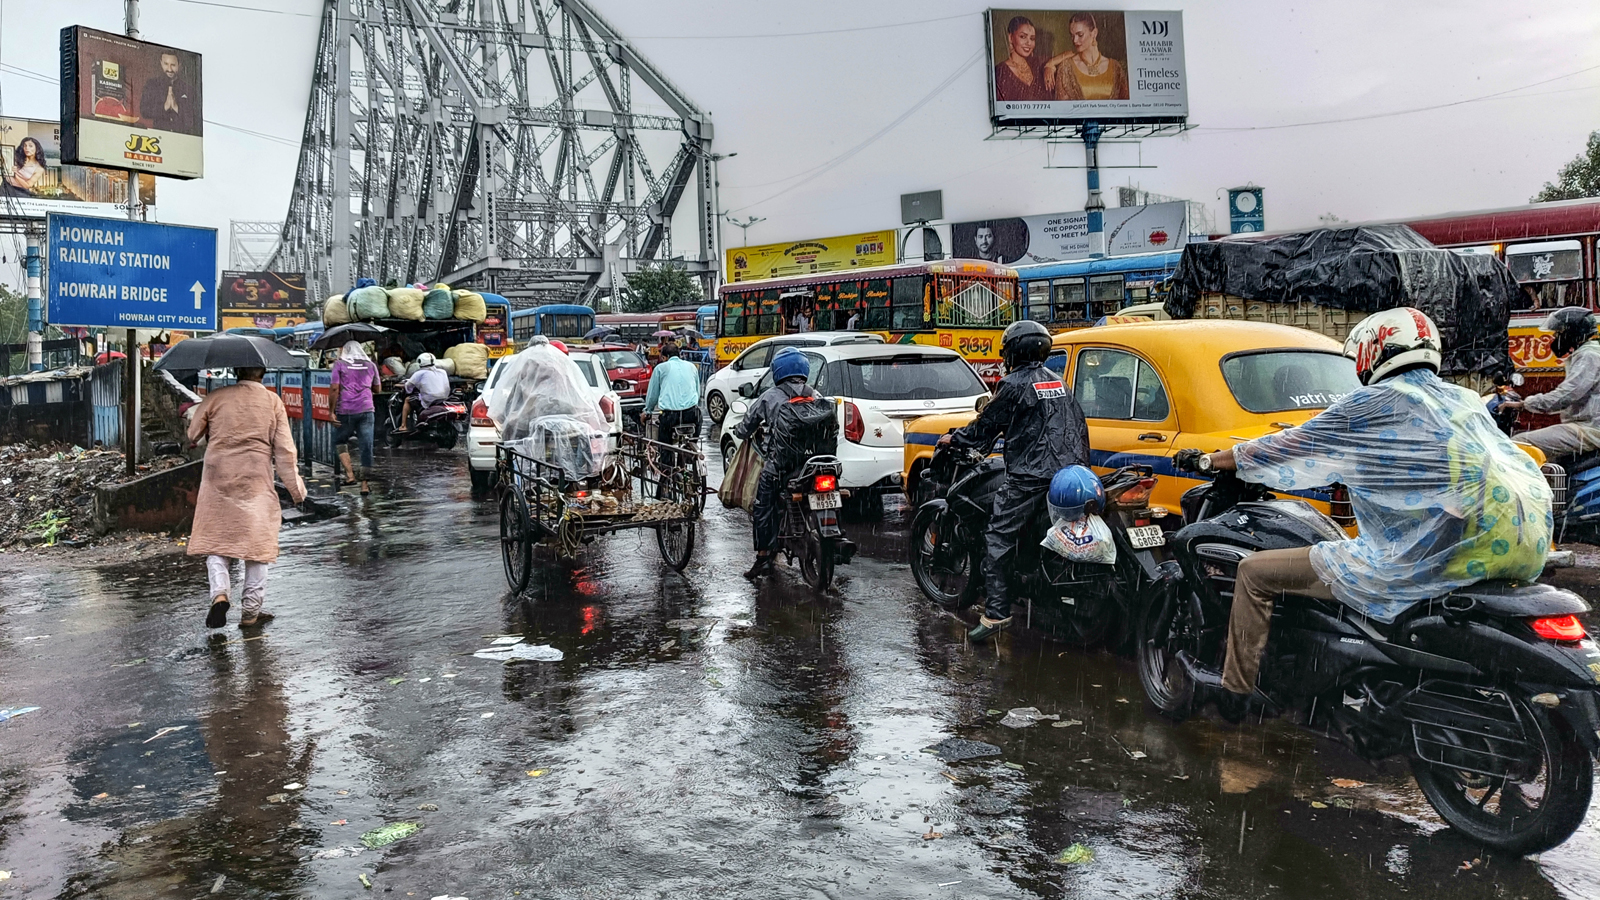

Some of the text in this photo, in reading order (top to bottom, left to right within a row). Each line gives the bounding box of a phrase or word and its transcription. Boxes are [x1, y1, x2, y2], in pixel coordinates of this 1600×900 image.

[1141, 20, 1169, 38] MDJ
[1136, 67, 1179, 78] Timeless
[1137, 79, 1181, 92] Elegance
[125, 133, 162, 155] JK
[126, 152, 162, 163] MASALE
[1063, 216, 1088, 224] SIGNAT
[1058, 224, 1089, 232] OPPORT
[59, 226, 124, 246] HOWRAH
[1062, 231, 1080, 239] MEET
[59, 247, 170, 270] RAILWAY STATION
[58, 281, 168, 303] HOWRAH BRIDGE
[245, 286, 259, 301] 3
[119, 312, 207, 325] HOWRAH CITY POLICE
[1110, 316, 1147, 324] TAXI
[958, 335, 996, 357] হাওড়া
[315, 392, 330, 409] DOLLA
[1289, 392, 1328, 407] yatri
[816, 493, 825, 502] WB
[1340, 636, 1365, 645] SUZUKI
